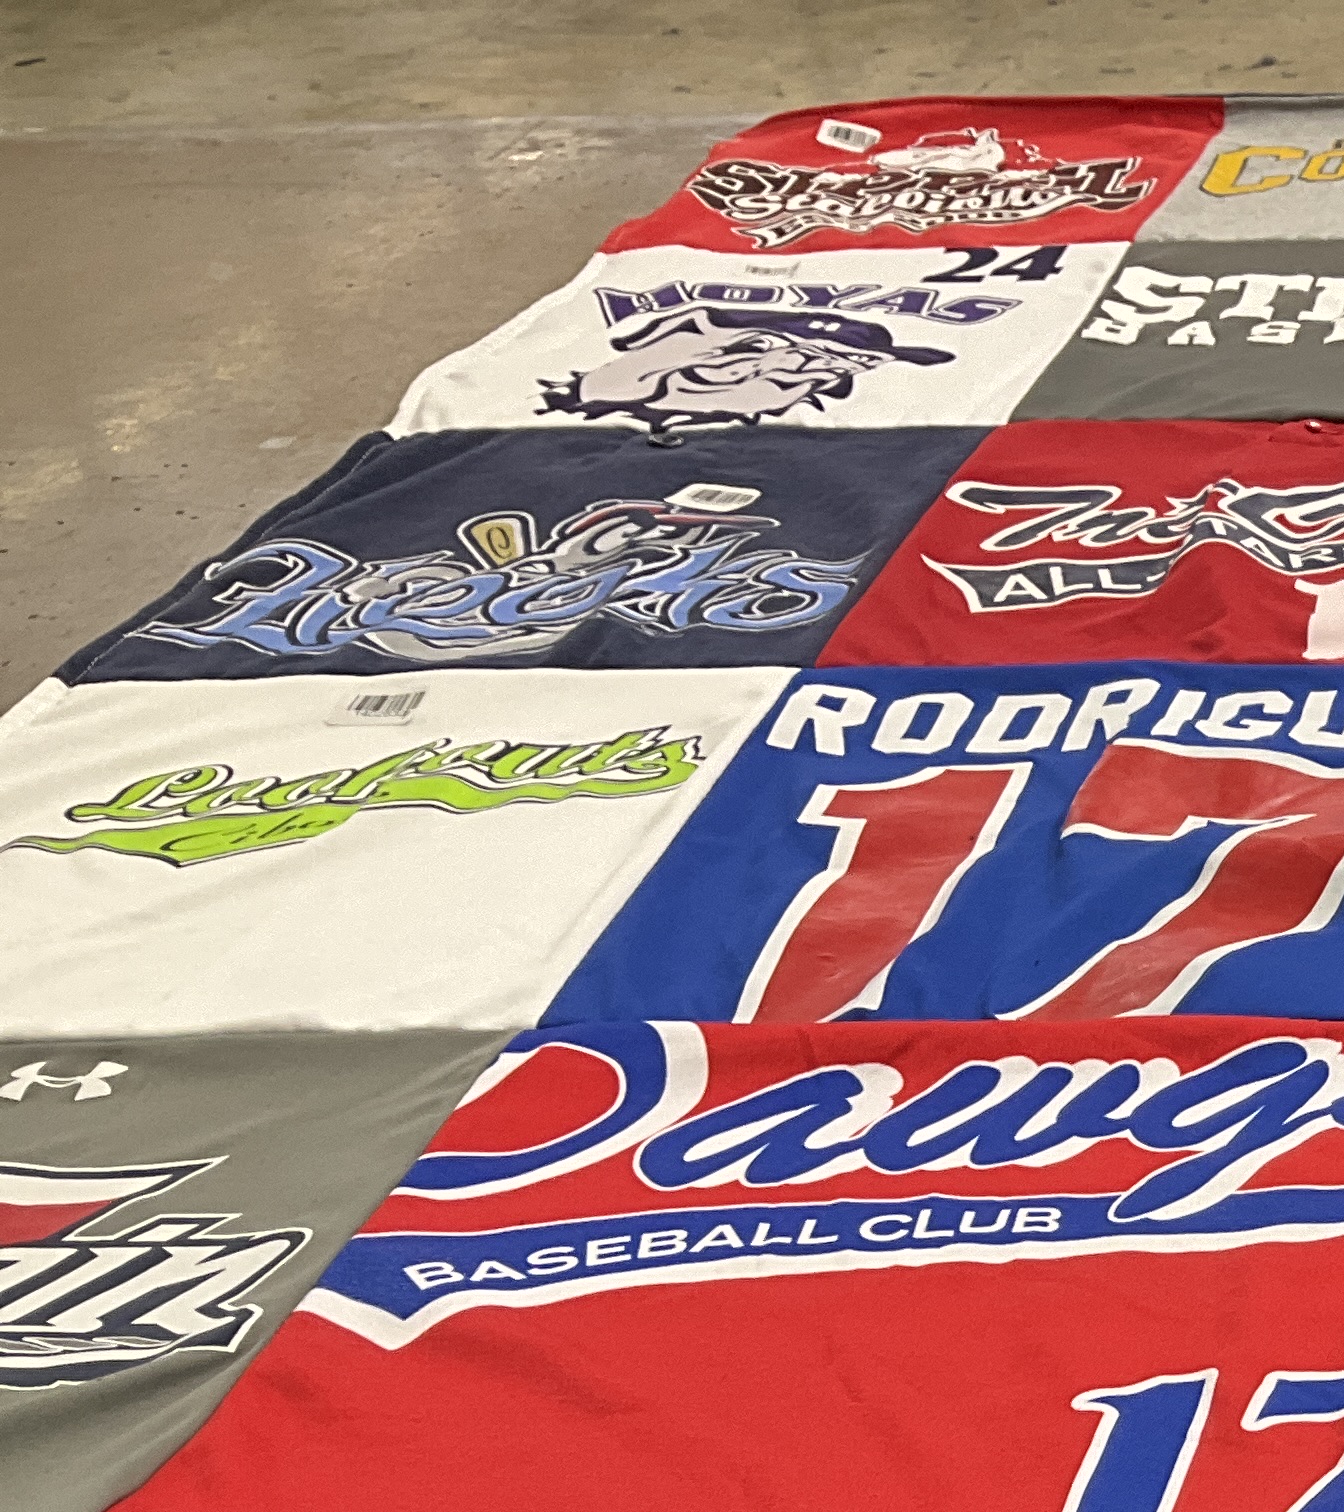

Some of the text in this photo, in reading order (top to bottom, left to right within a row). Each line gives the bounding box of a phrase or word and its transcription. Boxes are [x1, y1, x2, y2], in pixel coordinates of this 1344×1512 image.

[923, 244, 1068, 283] 24
[593, 281, 1023, 328] HOYAS
[404, 1204, 1065, 1291] BASEBALL CLUB
